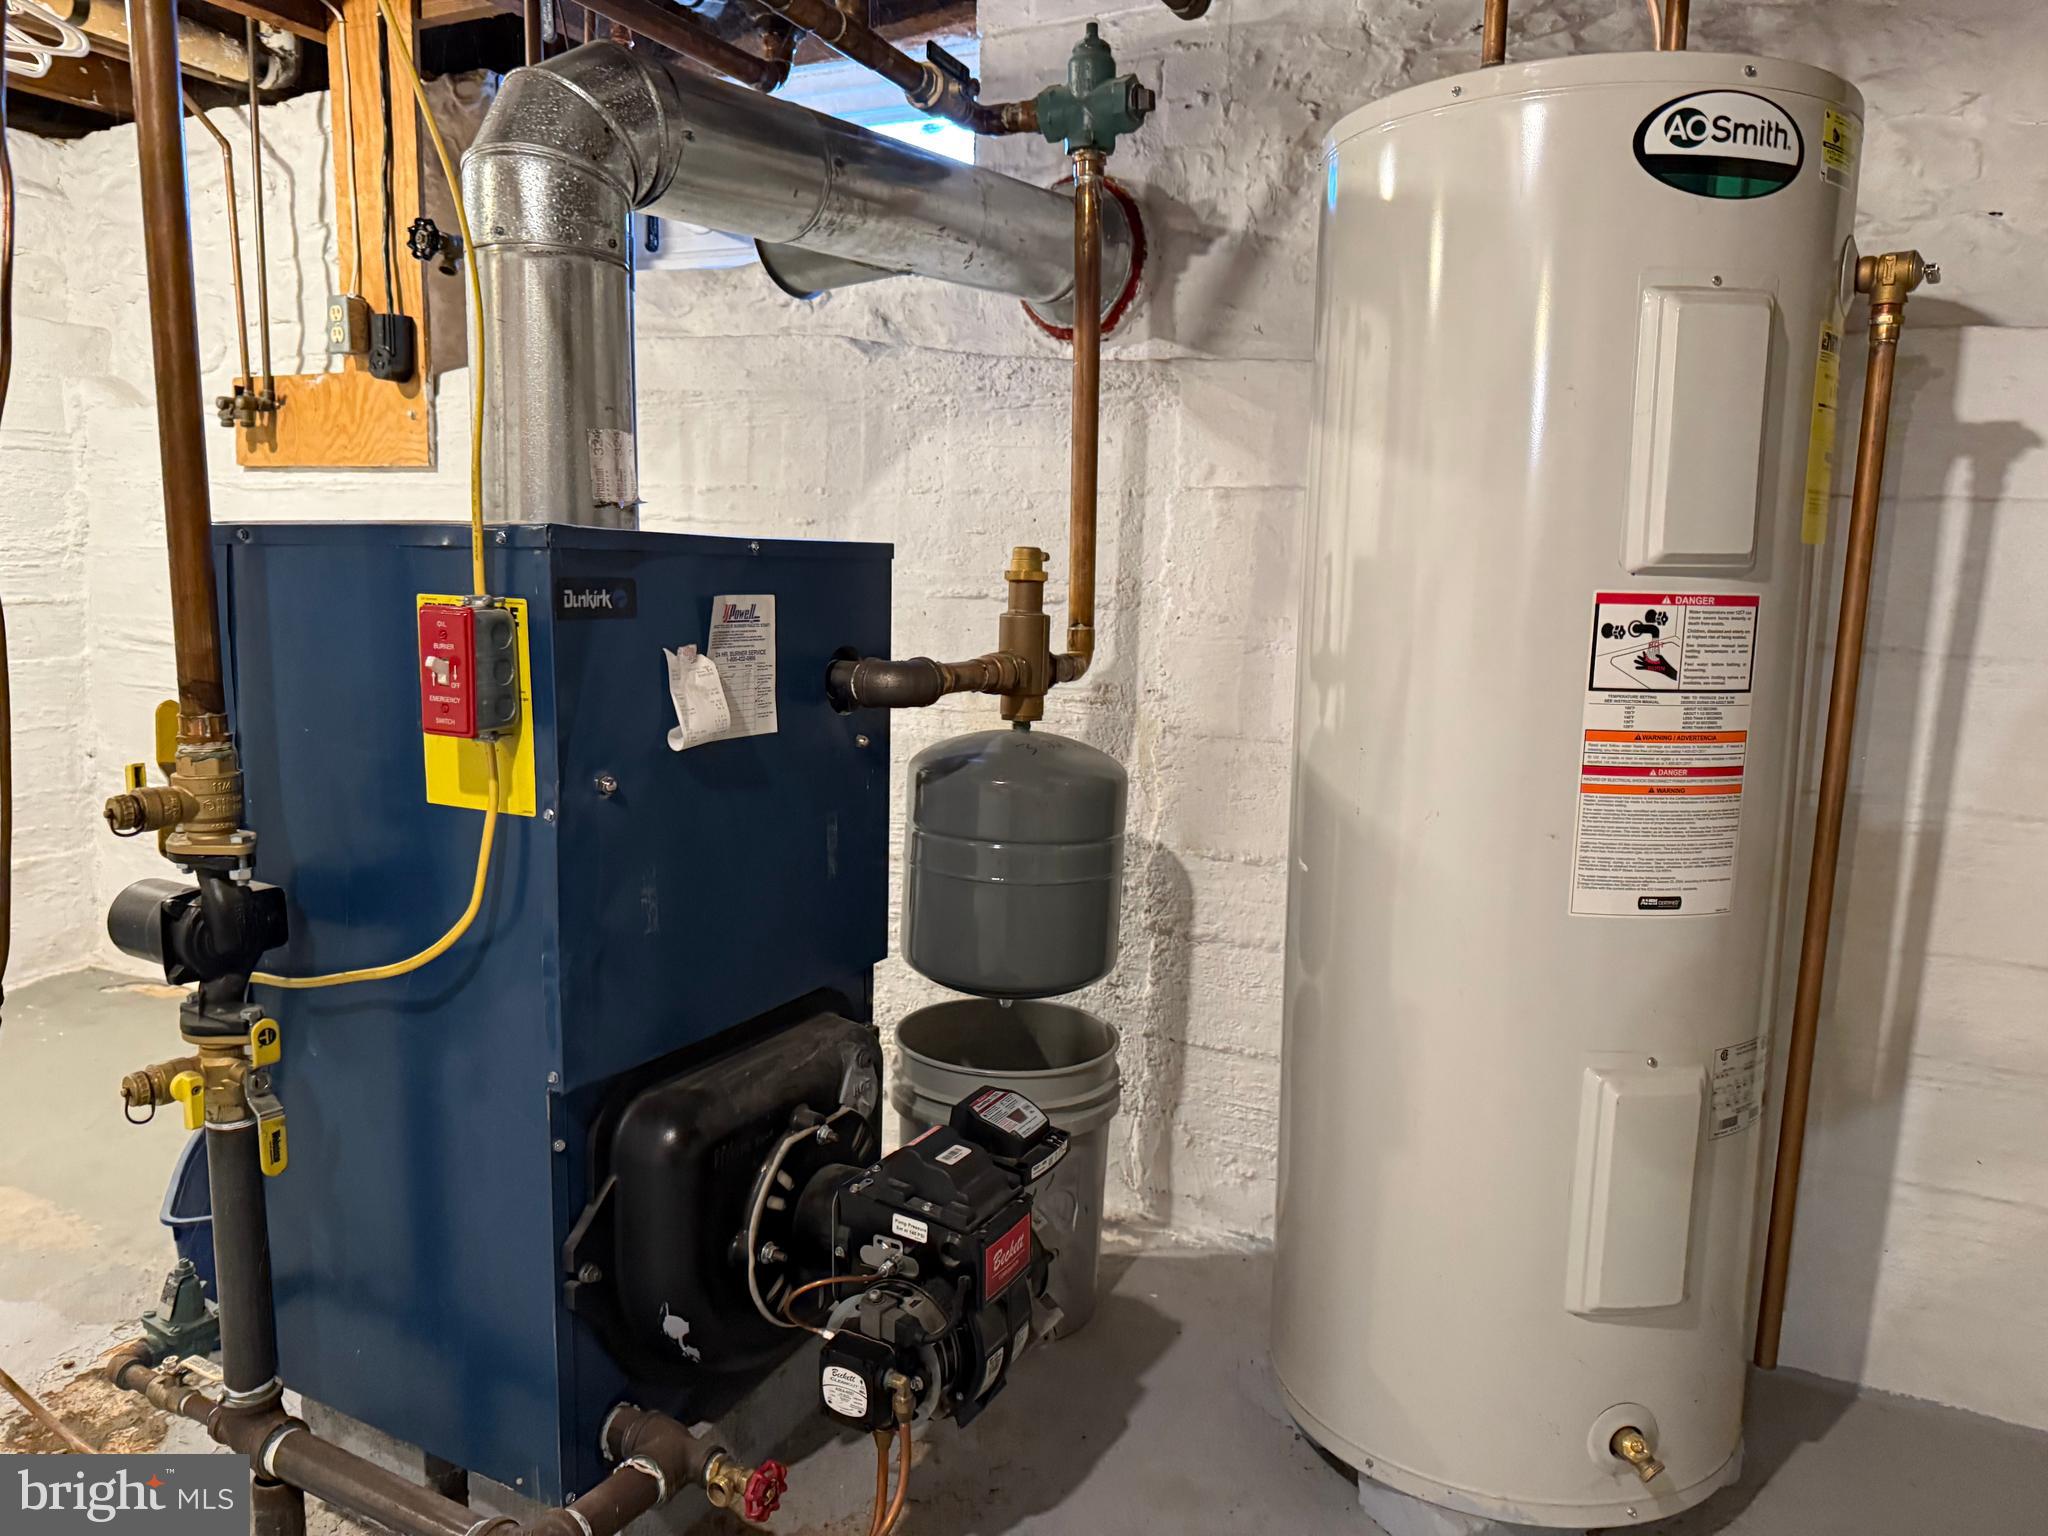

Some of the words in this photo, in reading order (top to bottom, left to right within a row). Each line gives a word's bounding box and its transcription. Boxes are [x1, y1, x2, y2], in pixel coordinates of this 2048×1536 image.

[1711, 115, 1789, 150] Smith
[563, 589, 613, 609] Dunkirk
[1675, 596, 1715, 605] DANGER
[429, 695, 461, 704] EMERGENCY
[435, 717, 456, 725] SWITCH
[992, 1231, 1025, 1272] Beckett
[831, 1368, 856, 1383] Beckett
